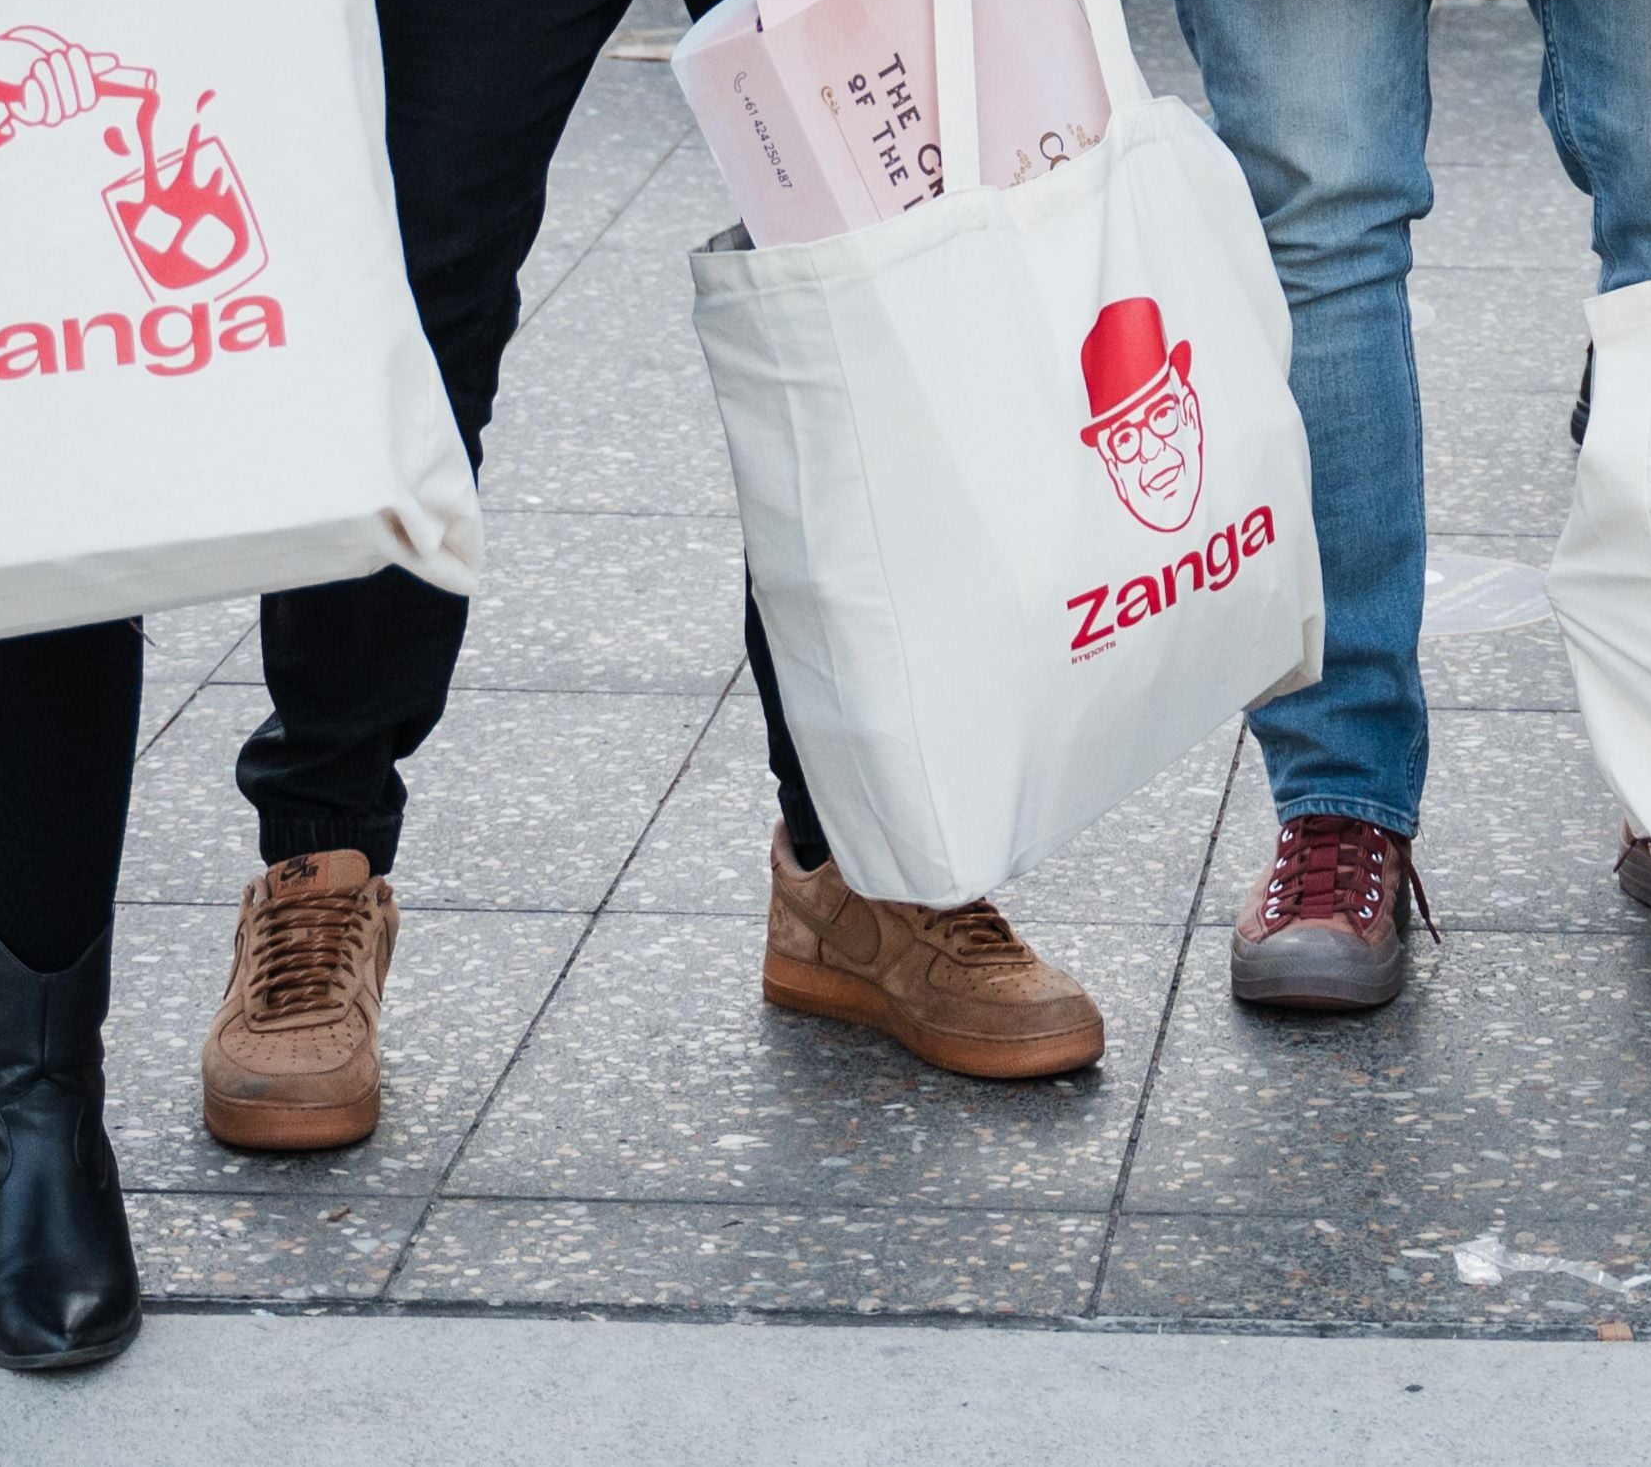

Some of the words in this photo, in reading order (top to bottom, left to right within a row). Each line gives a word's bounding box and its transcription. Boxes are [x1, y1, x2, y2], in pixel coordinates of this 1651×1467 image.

[744, 95, 759, 116] +61
[754, 119, 770, 142] 424
[763, 142, 781, 166] 250
[777, 167, 793, 189] 487
[847, 73, 876, 106] OF
[872, 119, 909, 187] THE
[878, 51, 921, 130] THE
[1066, 505, 1276, 651] Zanga
